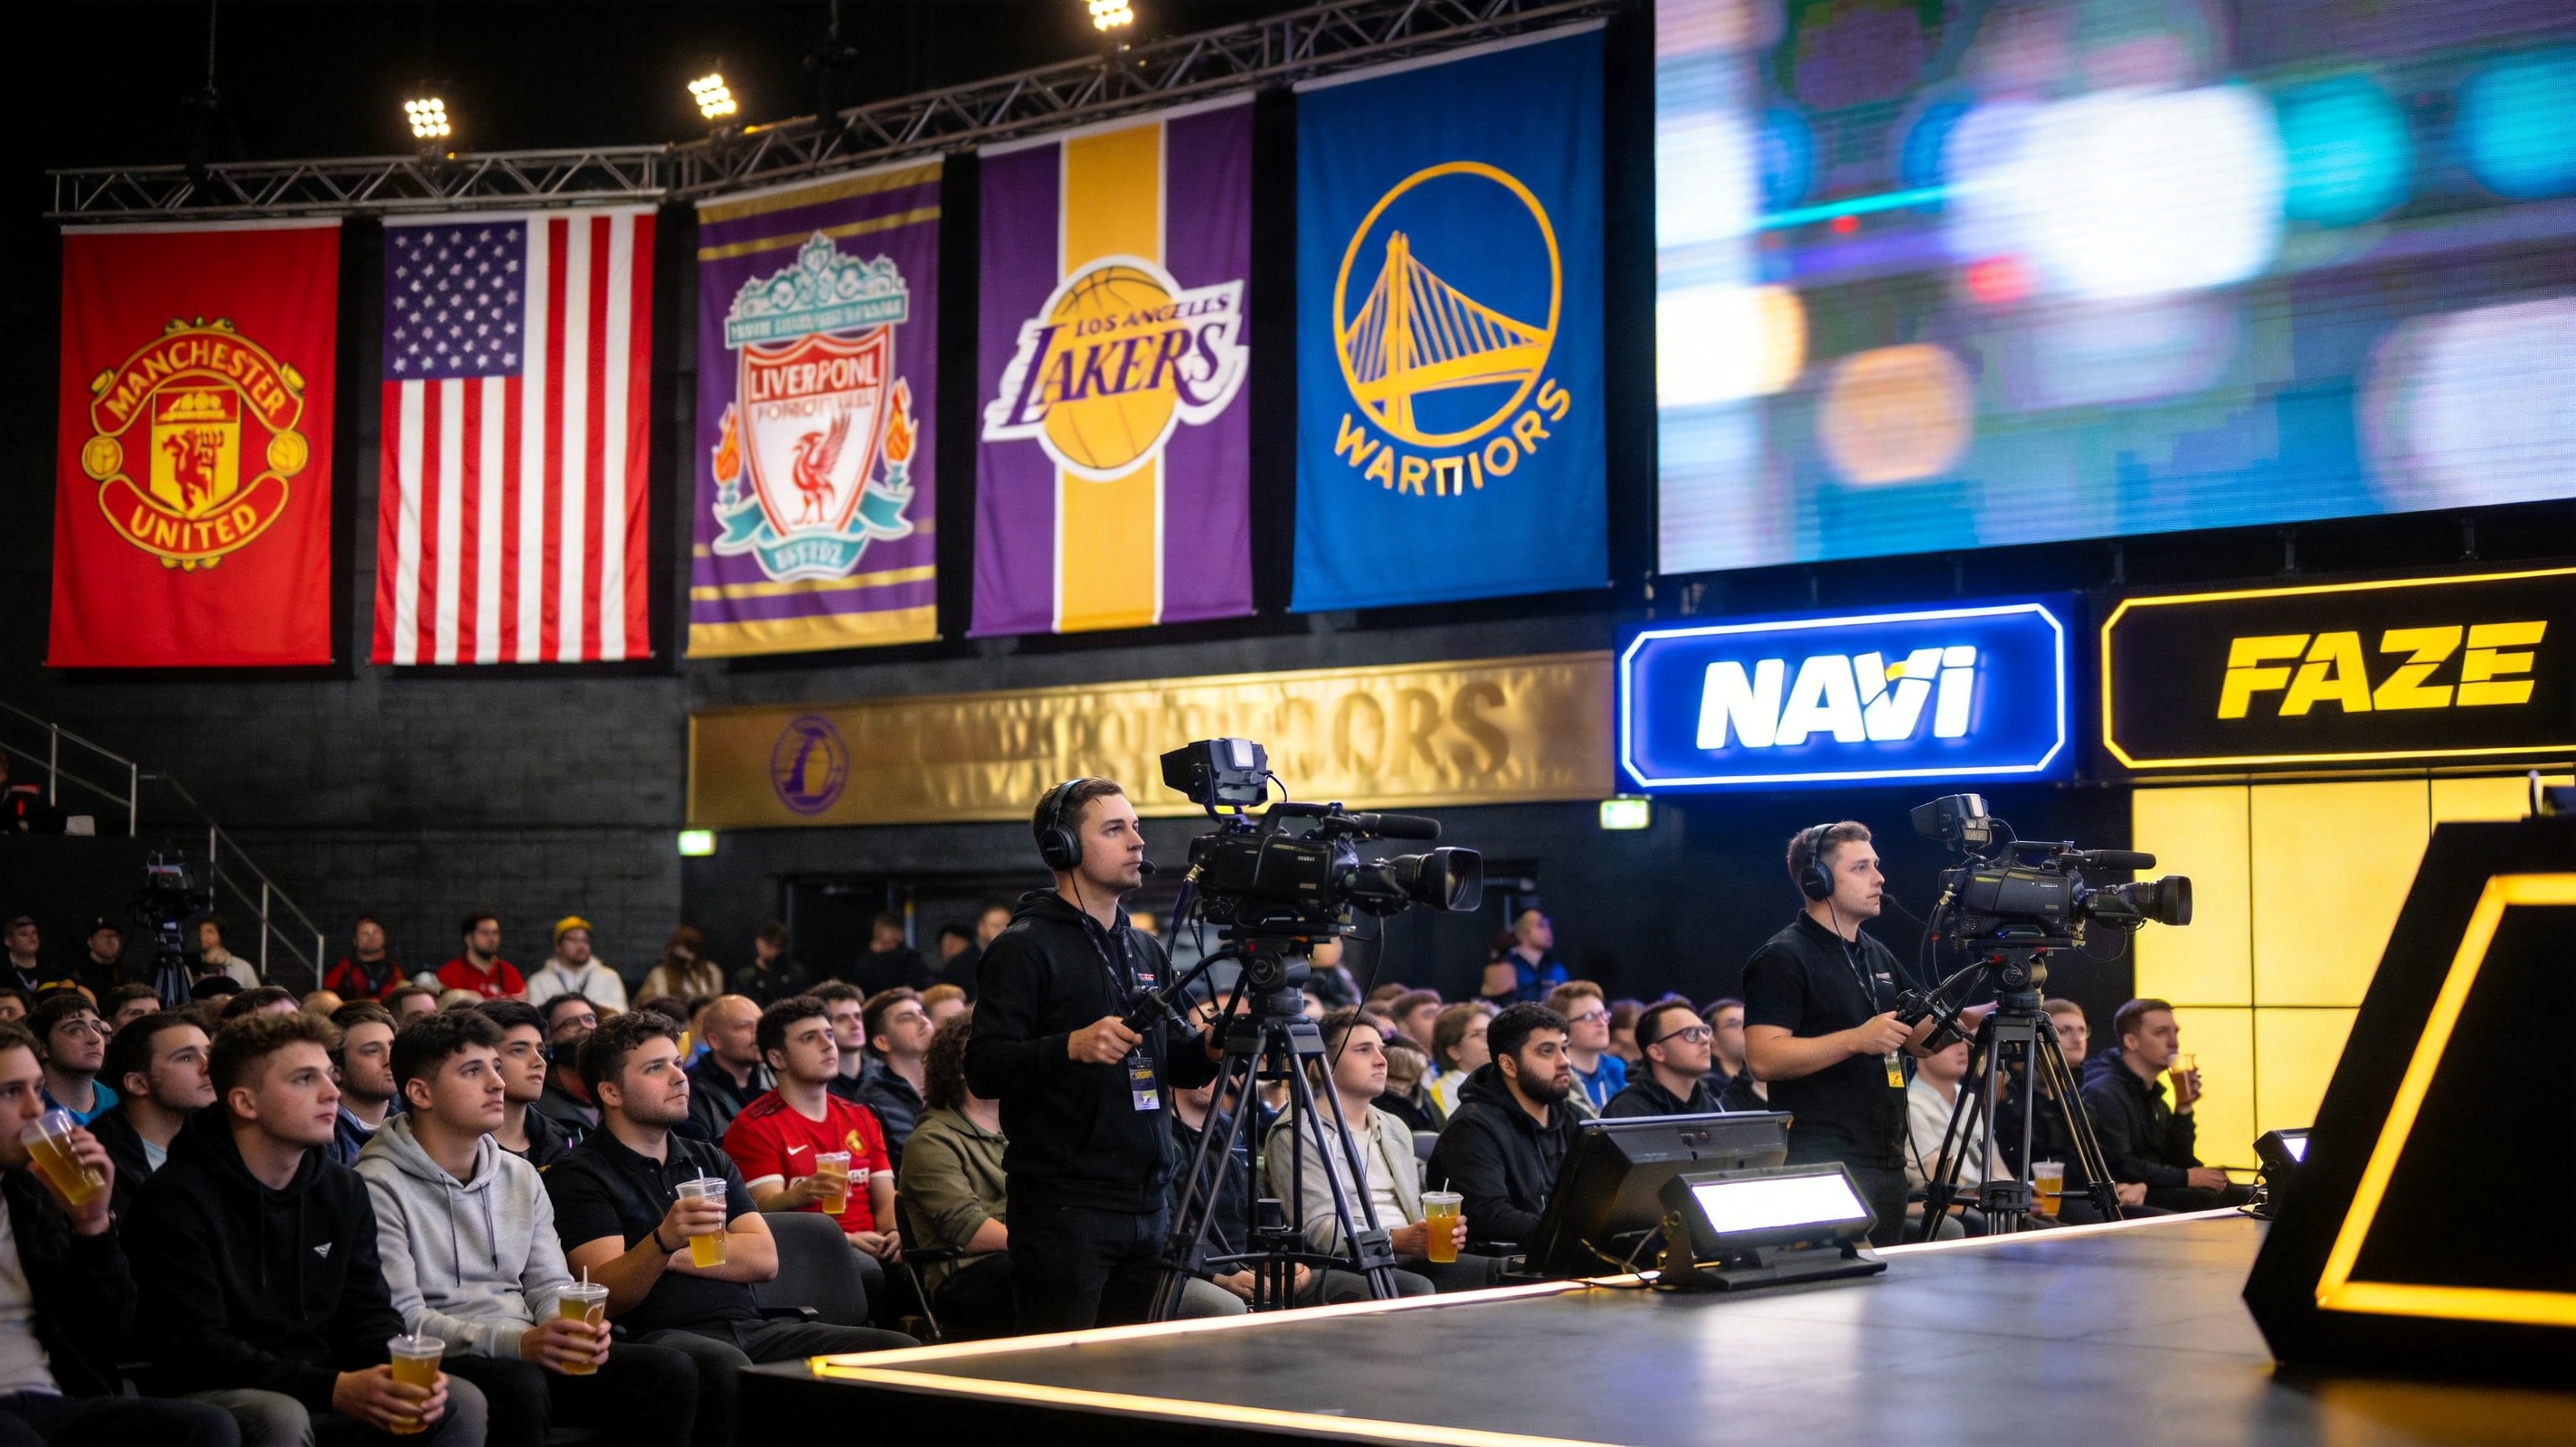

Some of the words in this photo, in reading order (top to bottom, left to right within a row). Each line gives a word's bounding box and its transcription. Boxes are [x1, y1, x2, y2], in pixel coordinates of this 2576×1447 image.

[1075, 314, 1118, 338] LOS
[1122, 293, 1231, 327] ANGELES
[104, 338, 287, 422] MANCHESTER
[998, 322, 1230, 428] LAKERS
[129, 502, 258, 551] UNITED
[2216, 619, 2549, 720] FAZE
